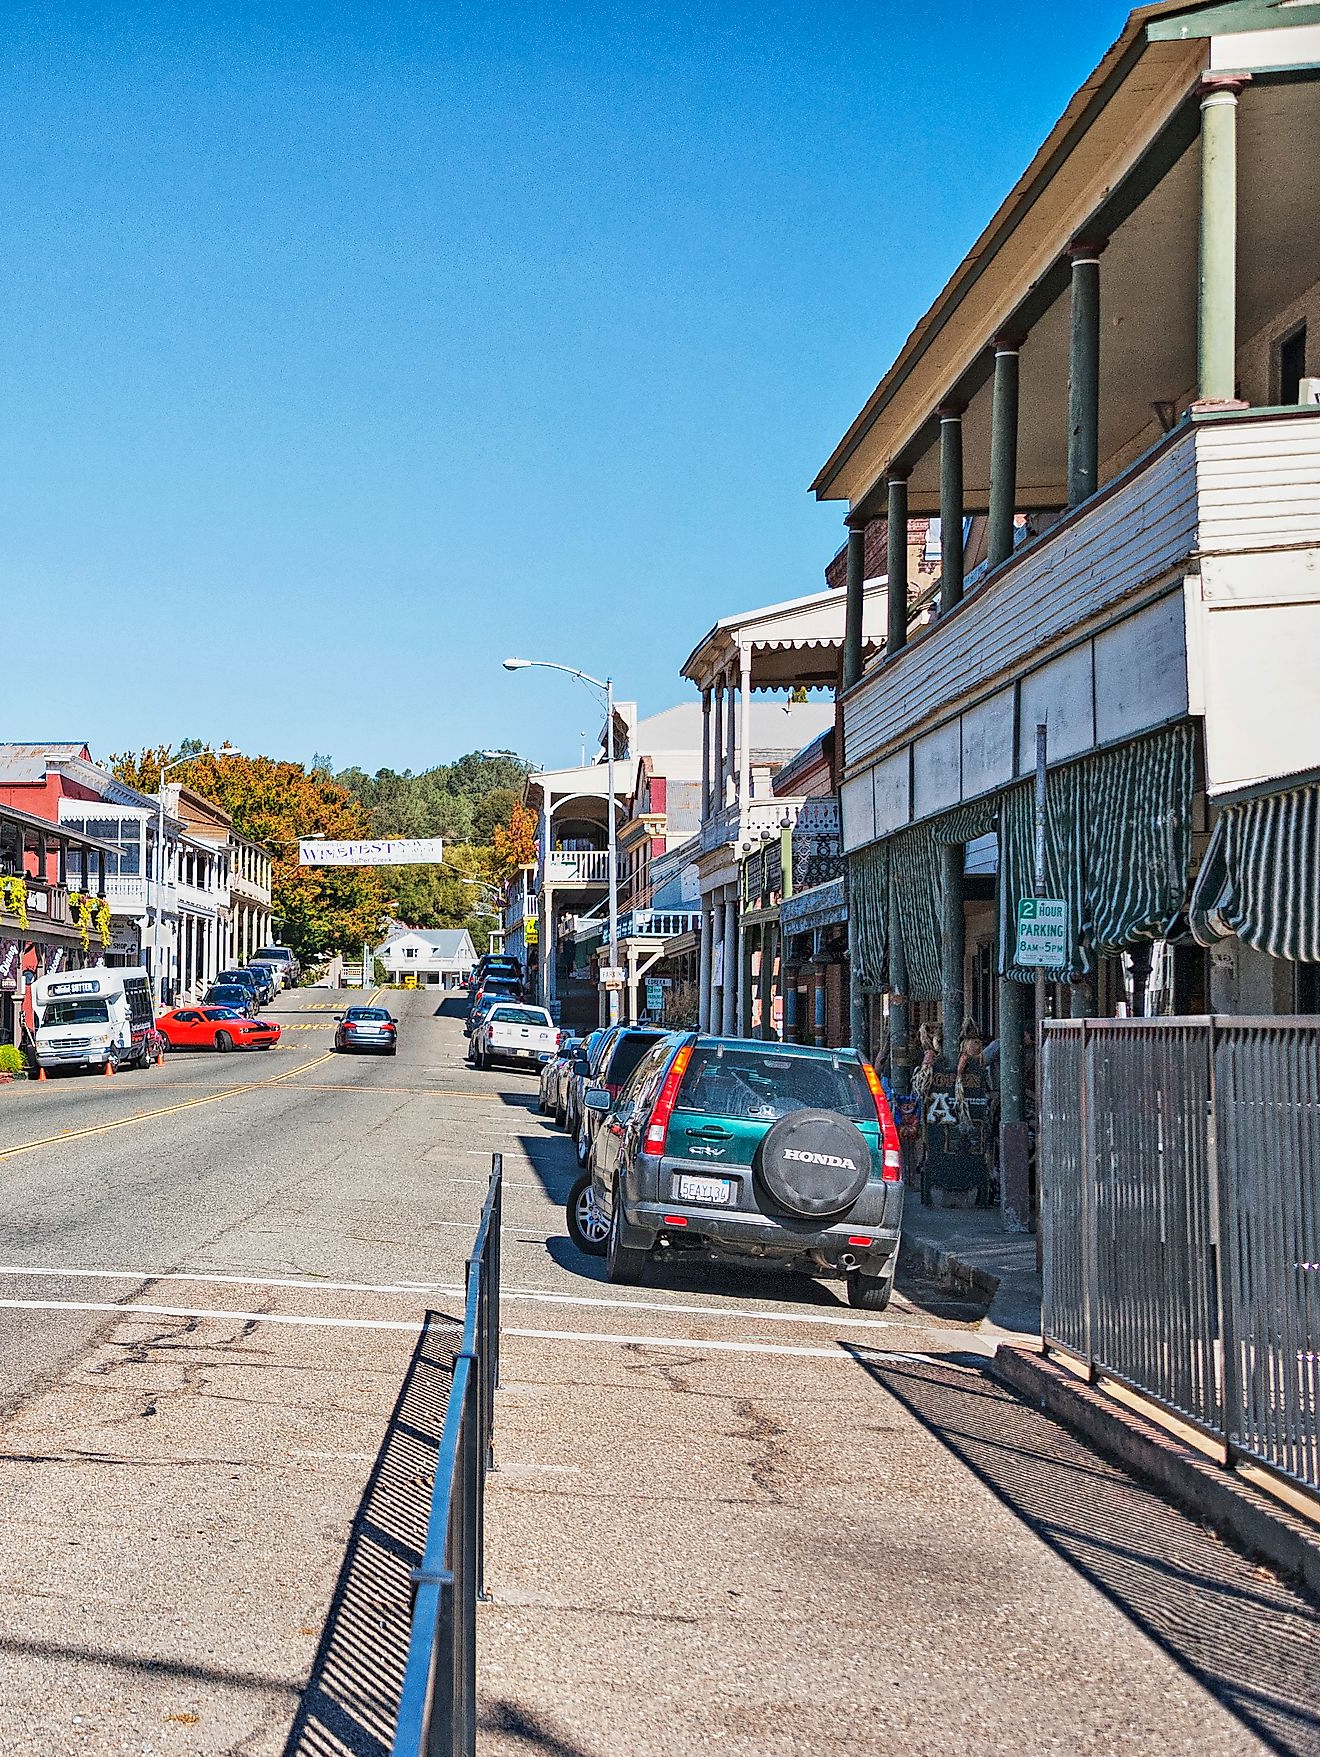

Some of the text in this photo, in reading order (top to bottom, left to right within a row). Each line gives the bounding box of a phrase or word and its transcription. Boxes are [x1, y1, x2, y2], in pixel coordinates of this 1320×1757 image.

[303, 843, 391, 861] WINEFEST
[1023, 902, 1062, 917] 2 HOUR
[1020, 924, 1063, 938] PARKING
[0, 944, 19, 977] Dining
[783, 1149, 856, 1170] HONDA
[683, 1182, 726, 1198] 5EAY134
